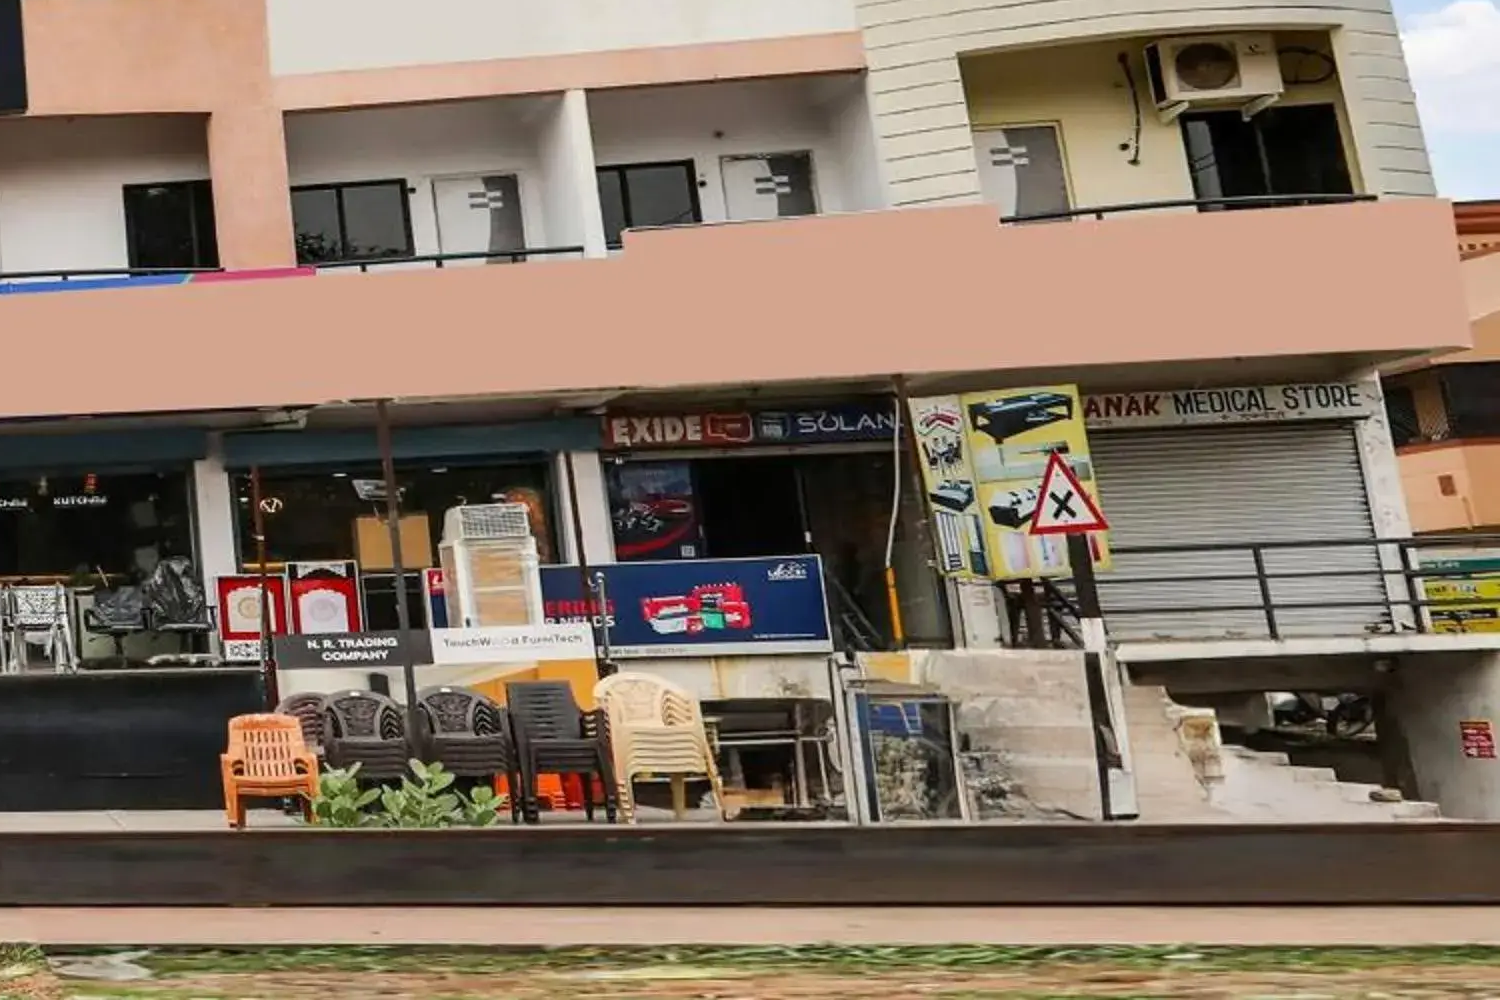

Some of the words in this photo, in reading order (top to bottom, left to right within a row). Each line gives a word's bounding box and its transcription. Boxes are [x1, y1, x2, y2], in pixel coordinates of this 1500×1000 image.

[1173, 387, 1277, 415] MEDICAL
[1284, 384, 1364, 411] STORE
[611, 414, 701, 445] EXIDE
[338, 637, 398, 648] TRADING
[321, 650, 389, 661] COMPANY
